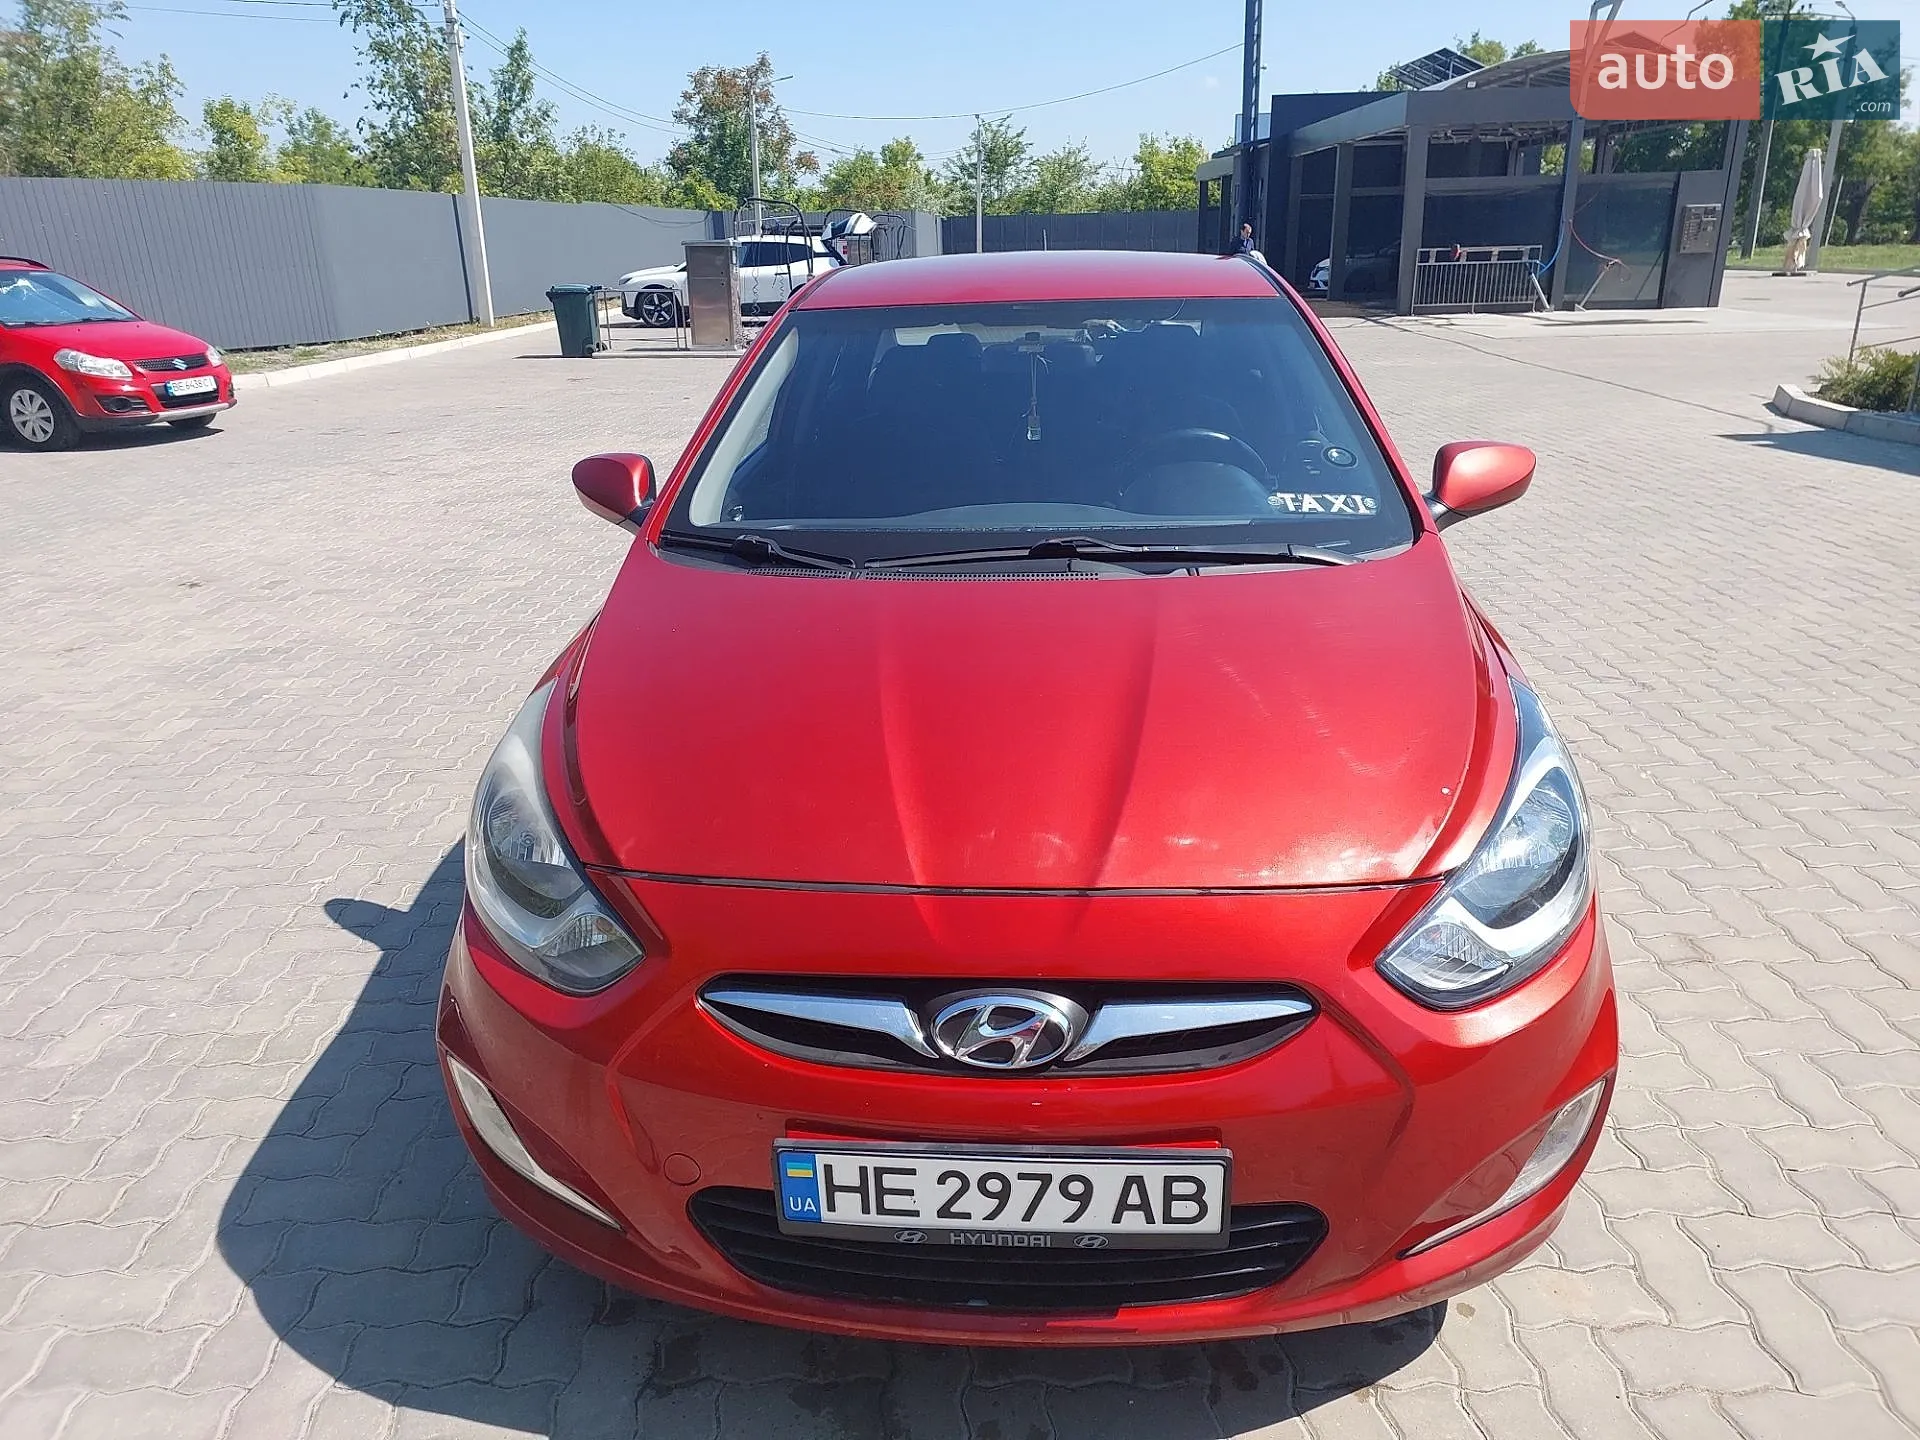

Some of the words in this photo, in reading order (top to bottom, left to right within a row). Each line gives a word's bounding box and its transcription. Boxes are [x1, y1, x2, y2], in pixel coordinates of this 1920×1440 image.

[1276, 492, 1371, 515] TAXI
[789, 1196, 817, 1213] UA
[823, 1164, 920, 1218] HE
[936, 1170, 1094, 1224] 2979
[1111, 1175, 1209, 1225] AB
[949, 1232, 1051, 1248] HYUNDAI
